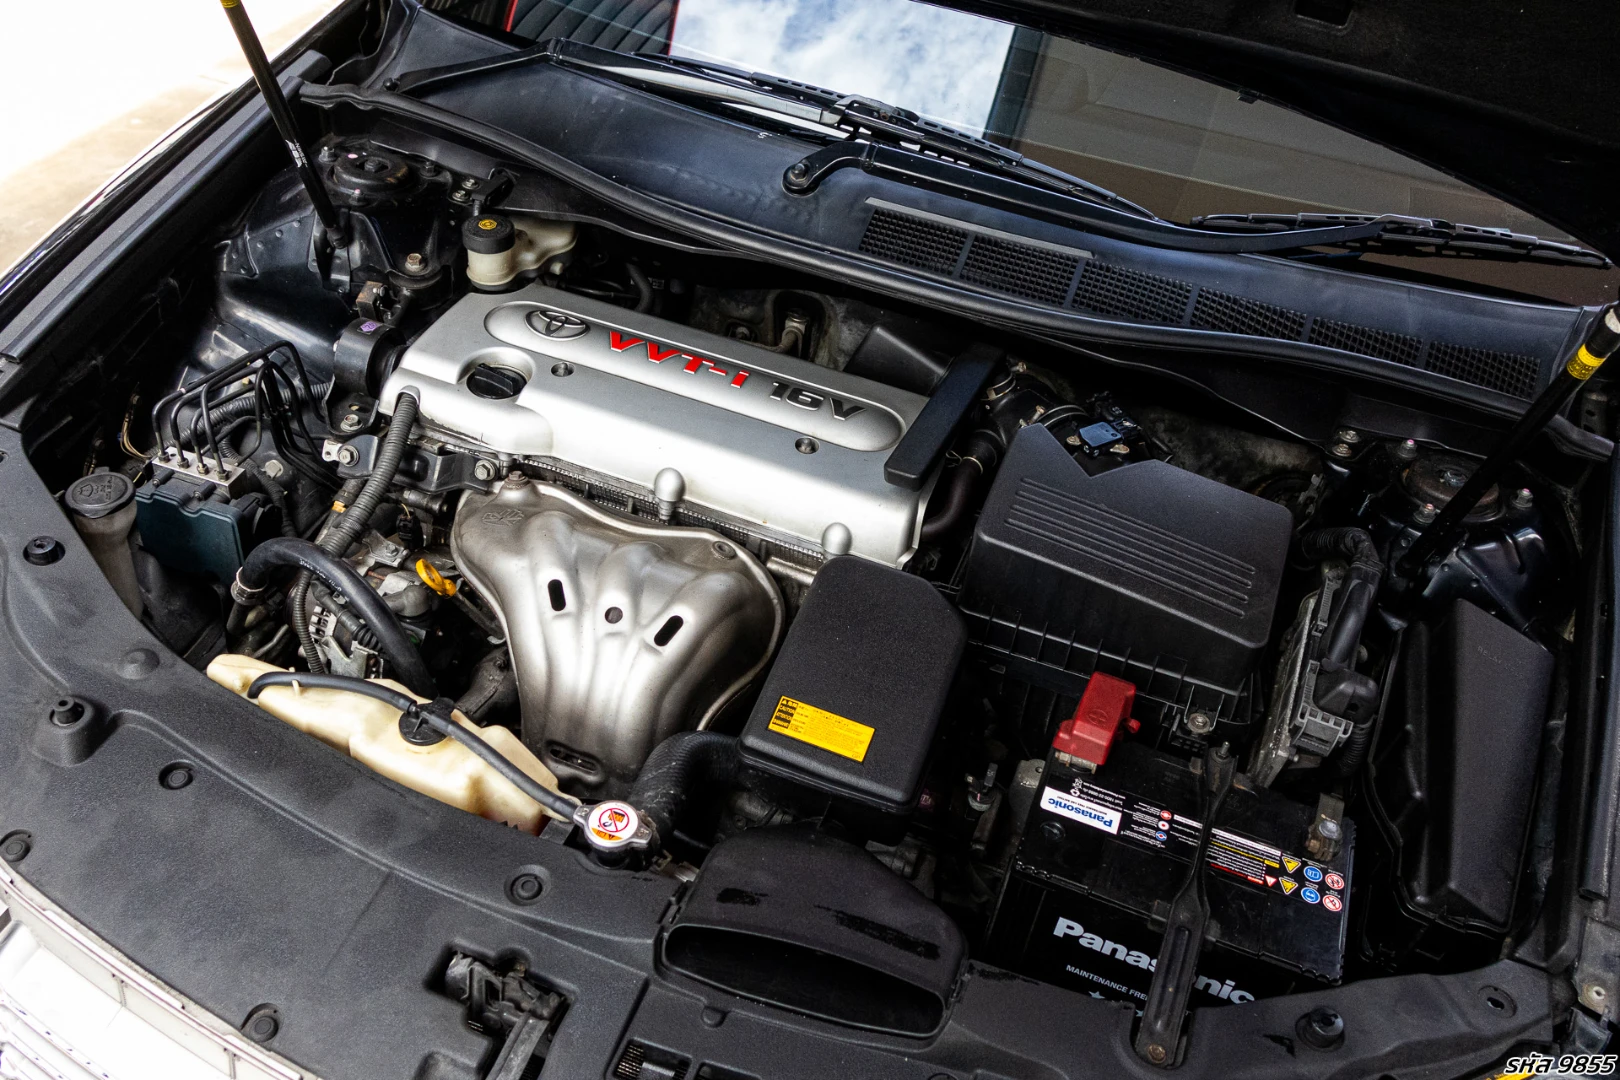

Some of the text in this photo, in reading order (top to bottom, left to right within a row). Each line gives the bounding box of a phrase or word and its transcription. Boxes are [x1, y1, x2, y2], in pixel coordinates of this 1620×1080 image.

[609, 331, 867, 420] VVT-i 16V
[1048, 798, 1113, 828] Panasonic
[1053, 916, 1255, 1004] Pananic
[1066, 964, 1127, 994] MAINTENANCE
